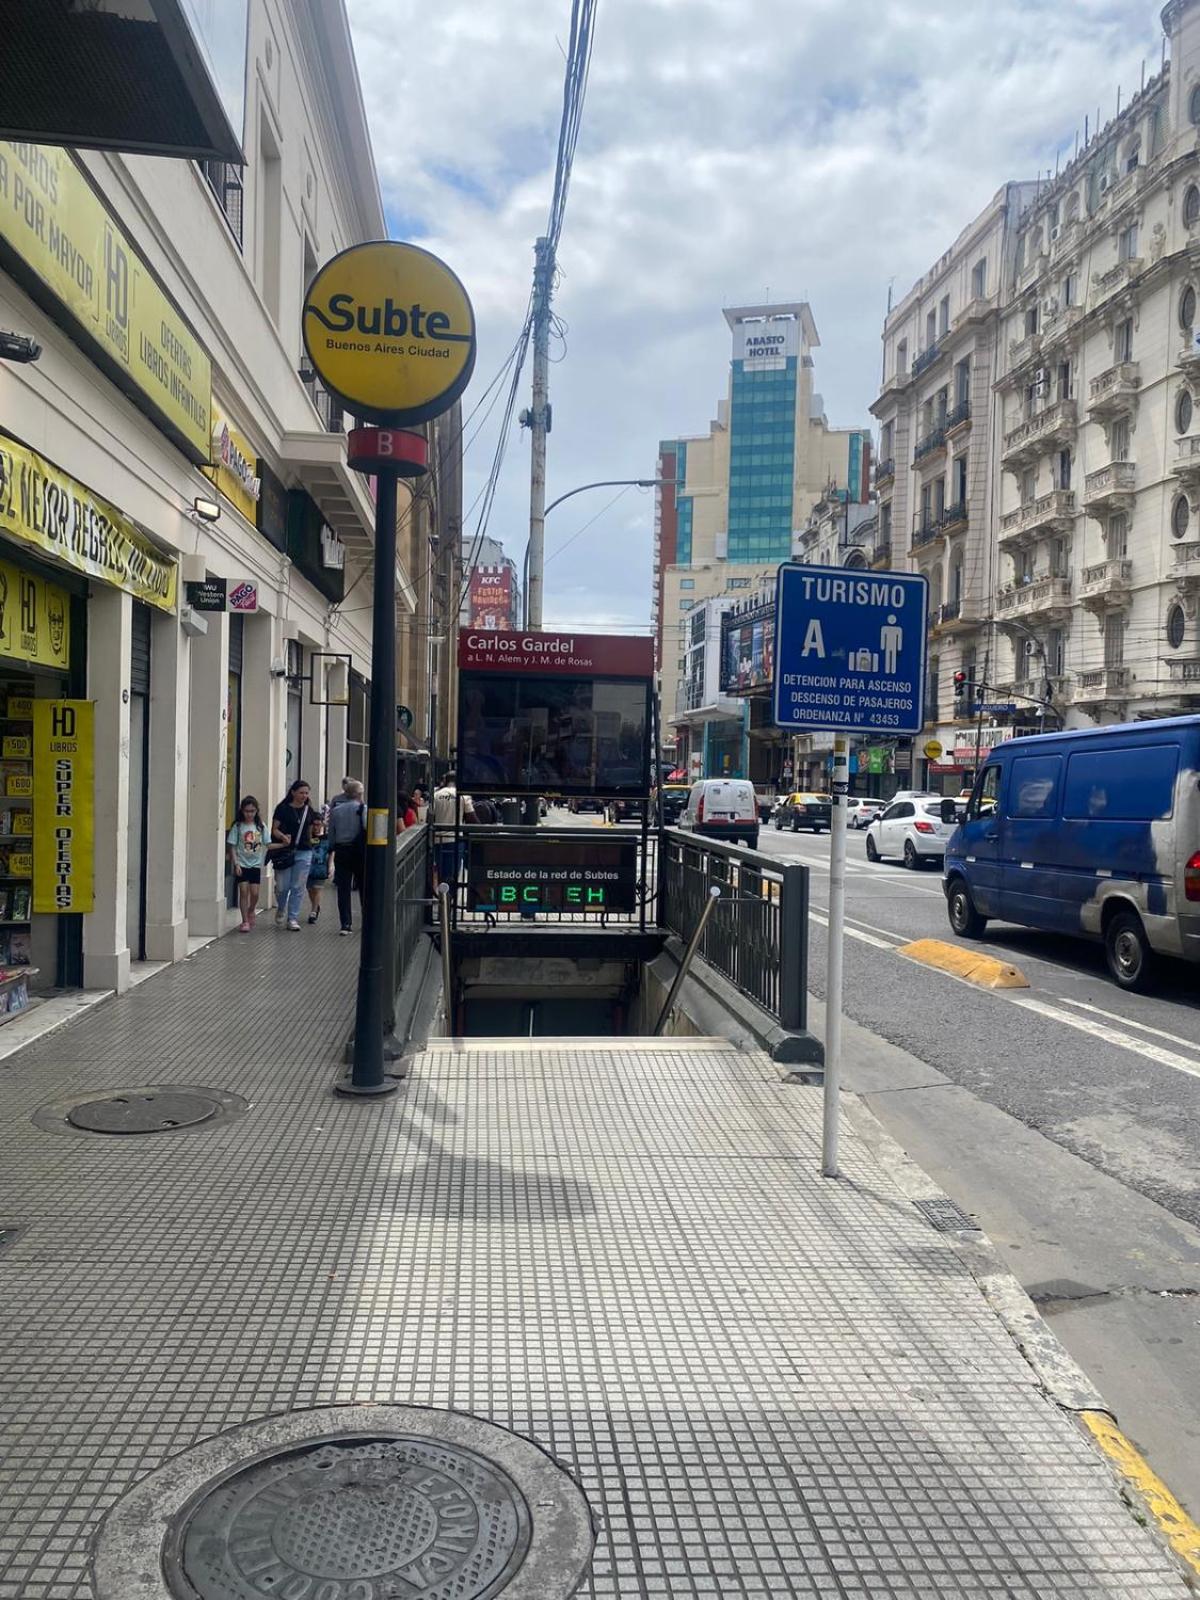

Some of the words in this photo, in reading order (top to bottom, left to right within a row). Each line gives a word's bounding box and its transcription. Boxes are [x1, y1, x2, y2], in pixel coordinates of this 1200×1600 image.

[14, 172, 45, 244] POR
[50, 215, 94, 301] MAYOR
[106, 229, 129, 329] HD
[326, 294, 451, 340] Subte
[161, 320, 192, 381] OFERTAS
[326, 338, 371, 353] Buenos
[374, 344, 404, 355] Aires
[408, 346, 450, 359] Ciudad
[746, 336, 785, 346] ABASTO
[749, 347, 781, 357] HOTEL
[140, 330, 169, 390] LIBROS
[170, 368, 207, 433] INFANTILES
[377, 432, 393, 456] B
[481, 576, 501, 584] KFC
[230, 584, 253, 606] PAGO
[802, 576, 905, 608] TURISMO
[21, 576, 36, 634] HD
[467, 635, 517, 650] Carlos
[522, 638, 574, 653] Gardel
[801, 619, 826, 659] A
[467, 654, 474, 662] a
[476, 654, 483, 662] L.
[486, 654, 496, 663] N.
[498, 654, 522, 663] Alem
[524, 656, 530, 665] y
[541, 656, 552, 665] M.
[555, 657, 566, 666] de
[568, 657, 593, 667] Rosas
[783, 673, 837, 688] DETENCION
[840, 677, 865, 690] PARA
[868, 680, 912, 693] ASCENSO
[791, 692, 840, 705] DESCENSO
[843, 695, 855, 706] DE
[859, 697, 913, 710] PASAJEROS
[52, 707, 76, 737] HD
[793, 708, 851, 722] ORDENANZA
[869, 714, 900, 725] 43453
[50, 742, 78, 753] LIBROS
[56, 759, 72, 816] SUPER
[56, 828, 72, 908] OFERTAS
[487, 870, 522, 879] Estado
[524, 870, 537, 879] de
[539, 870, 549, 879] la
[551, 870, 567, 879] red
[570, 871, 582, 880] de
[584, 871, 619, 880] Subtes
